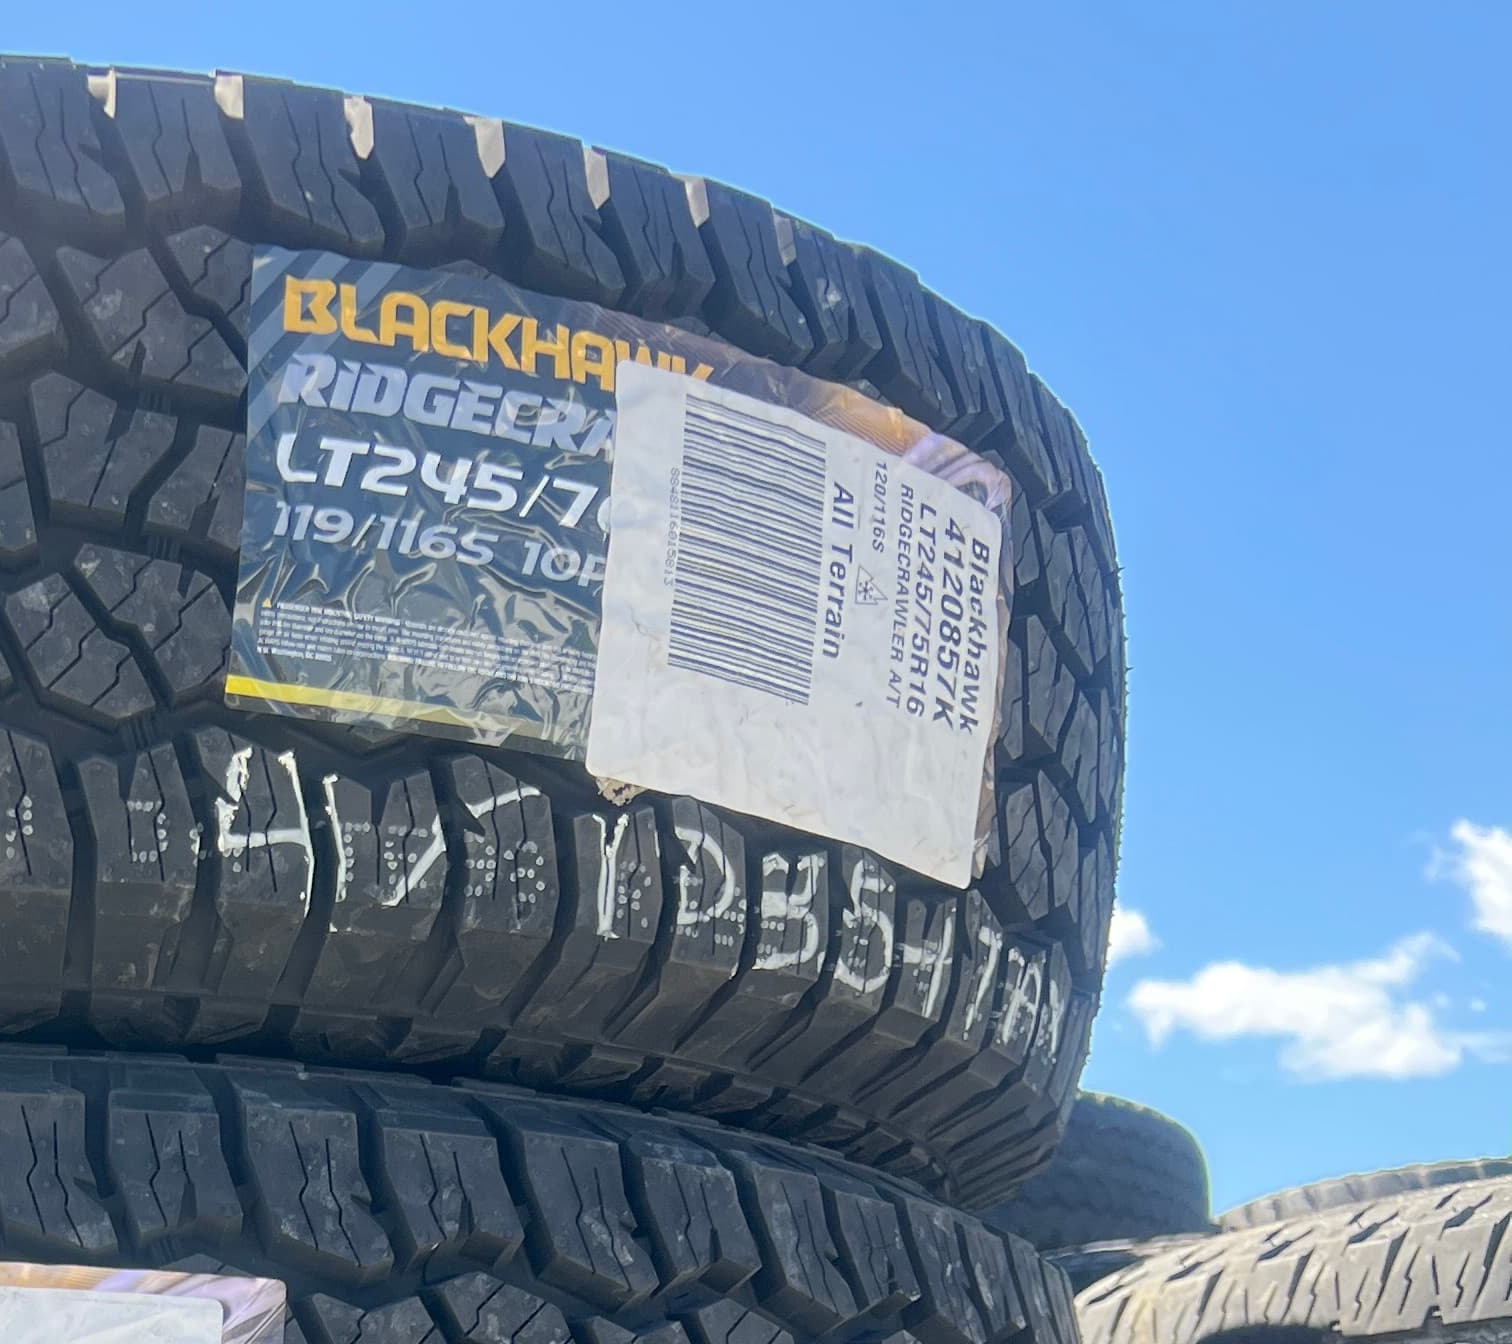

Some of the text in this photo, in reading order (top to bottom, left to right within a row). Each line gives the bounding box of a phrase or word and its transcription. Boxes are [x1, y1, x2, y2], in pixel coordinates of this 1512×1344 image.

[283, 274, 715, 393] BLACKHA
[272, 500, 501, 567] 119/116S
[276, 431, 610, 533] LT245/7
[823, 481, 854, 660] All Terrain
[872, 461, 888, 553] 120/116S
[886, 483, 914, 709] RIDGECRAWLER A/T
[906, 502, 937, 717] LT245/75R16
[933, 518, 966, 730] 4120857K
[960, 537, 990, 735] Blackhawk
